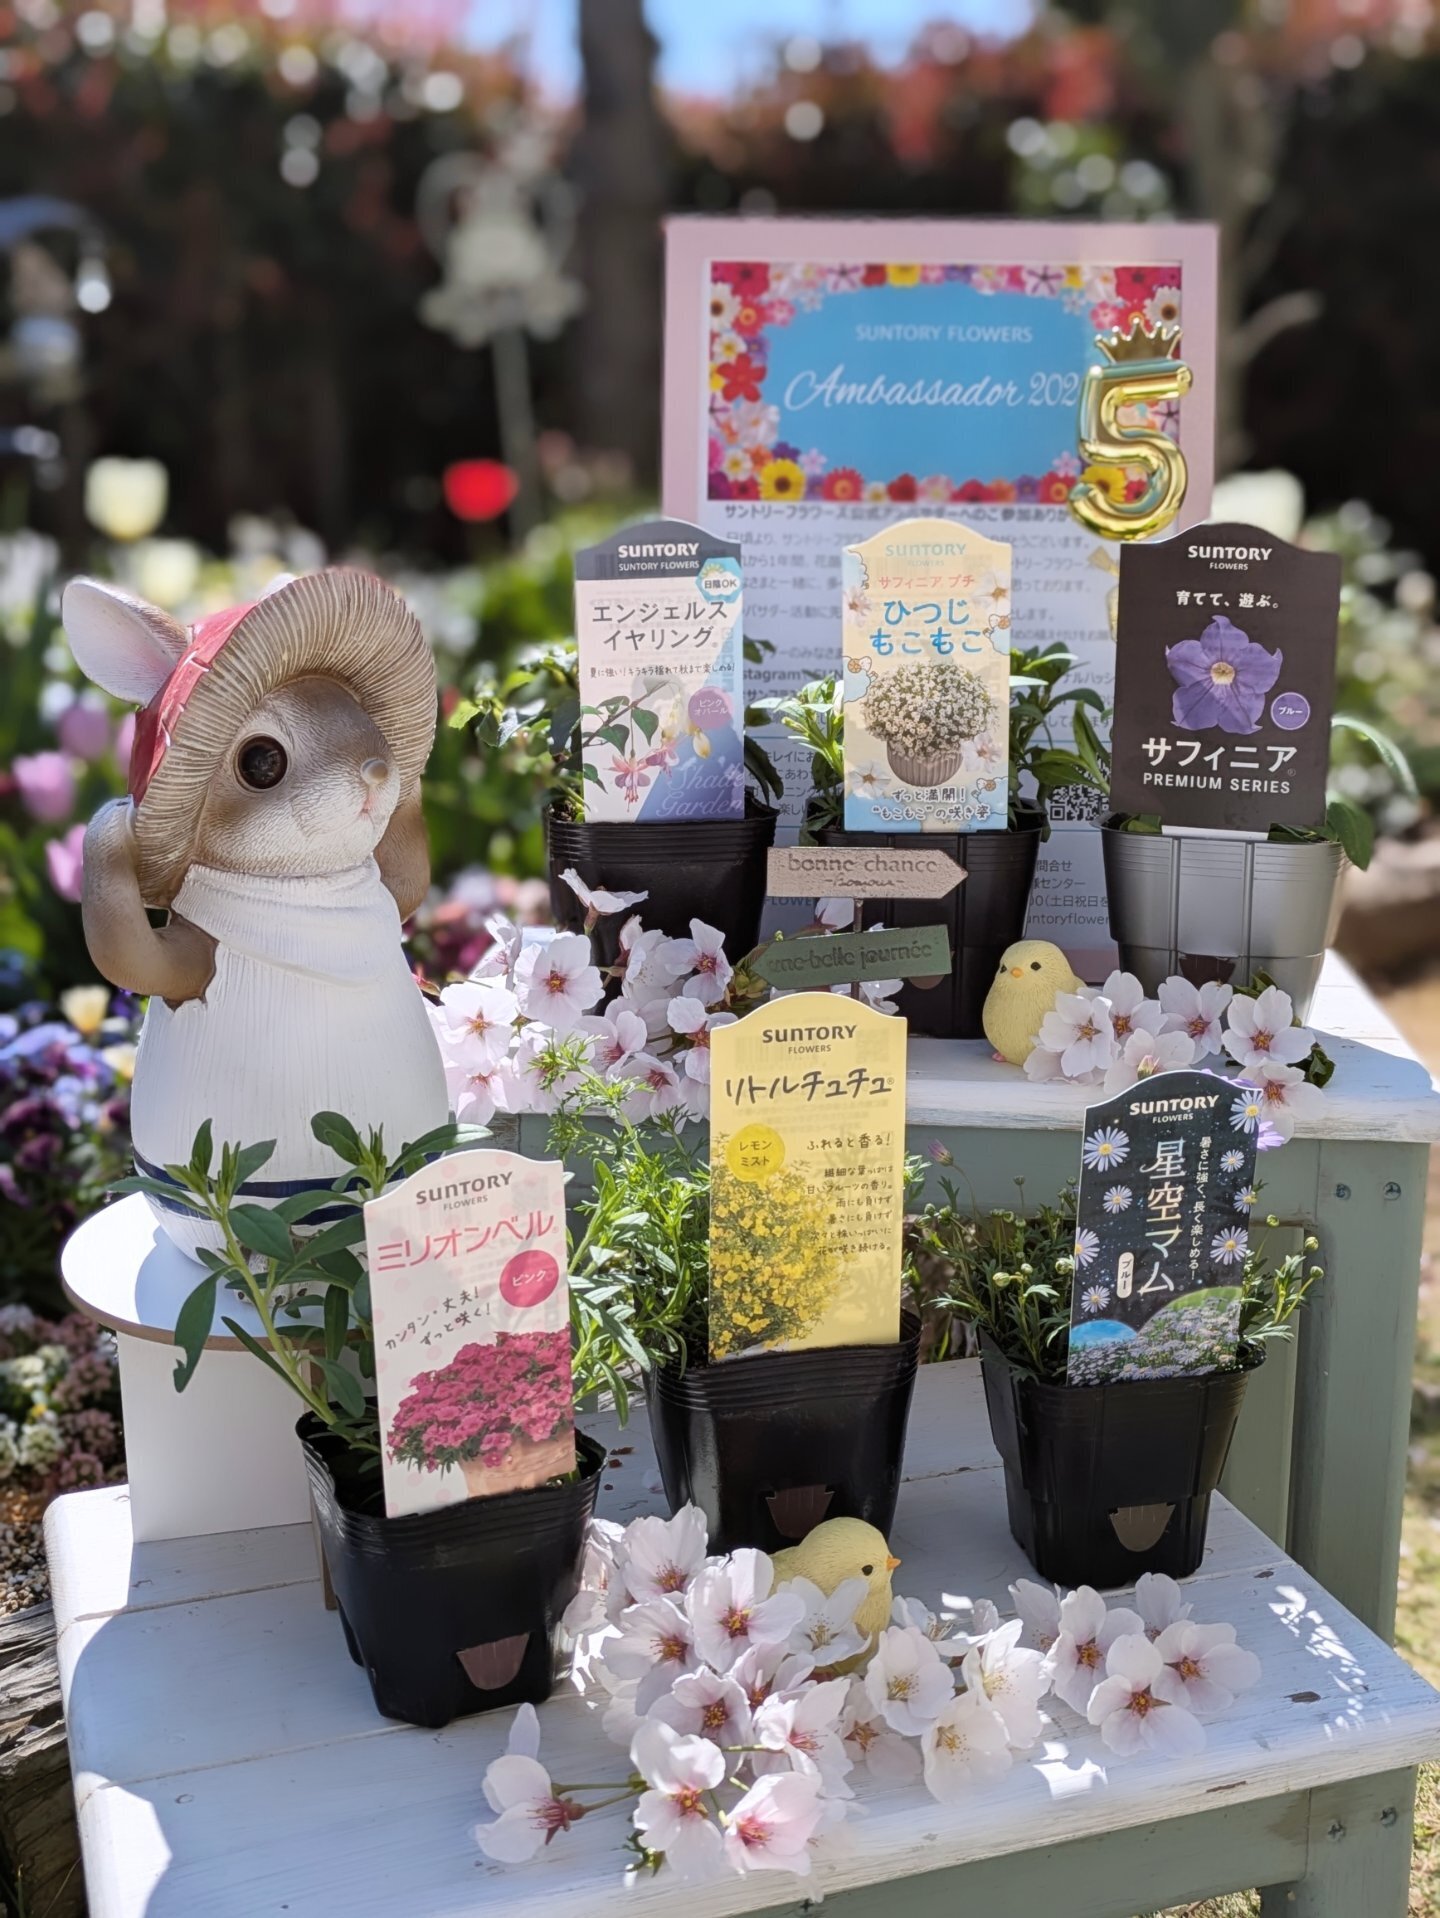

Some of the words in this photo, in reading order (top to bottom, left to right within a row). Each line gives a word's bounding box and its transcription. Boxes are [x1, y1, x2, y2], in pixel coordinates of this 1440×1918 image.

[855, 324, 942, 342] SUNTORY
[947, 325, 1033, 343] FLOWERS
[785, 363, 1024, 411] Ambassador
[618, 543, 699, 558] SUNTORY
[885, 543, 966, 557] SUNTORY
[1188, 545, 1272, 561] SUNTORY
[618, 561, 659, 571] SUNTORY
[660, 560, 700, 570] FLOWERS
[1209, 561, 1249, 571] FLOWERS
[878, 576, 943, 590] サフィニア
[1176, 590, 1279, 609] 育てて、遊ぶ。
[592, 600, 728, 623] エンジェルス
[883, 598, 970, 625] ひつじ
[869, 626, 983, 656] もこもこ
[1278, 705, 1304, 716] ブルー
[1143, 772, 1222, 790] PREMIUM
[1230, 777, 1291, 794] SERIES
[788, 853, 855, 872] bonne
[864, 854, 938, 873] chance
[861, 940, 933, 970] journée
[762, 1024, 858, 1044] SUNTORY
[787, 1044, 832, 1055] FLOWERS
[1129, 1094, 1220, 1116] SUNTORY
[1152, 1112, 1194, 1124] FLOWERS
[739, 1139, 773, 1151] レモン
[806, 1132, 891, 1151] ふれると香る!
[740, 1155, 771, 1167] ミスト
[415, 1171, 514, 1205] SUNTORY
[443, 1195, 489, 1211] FLOWERS
[1137, 1136, 1188, 1297] 星空マム
[511, 1269, 547, 1287] ピンク
[1118, 1260, 1132, 1290] ブルー
